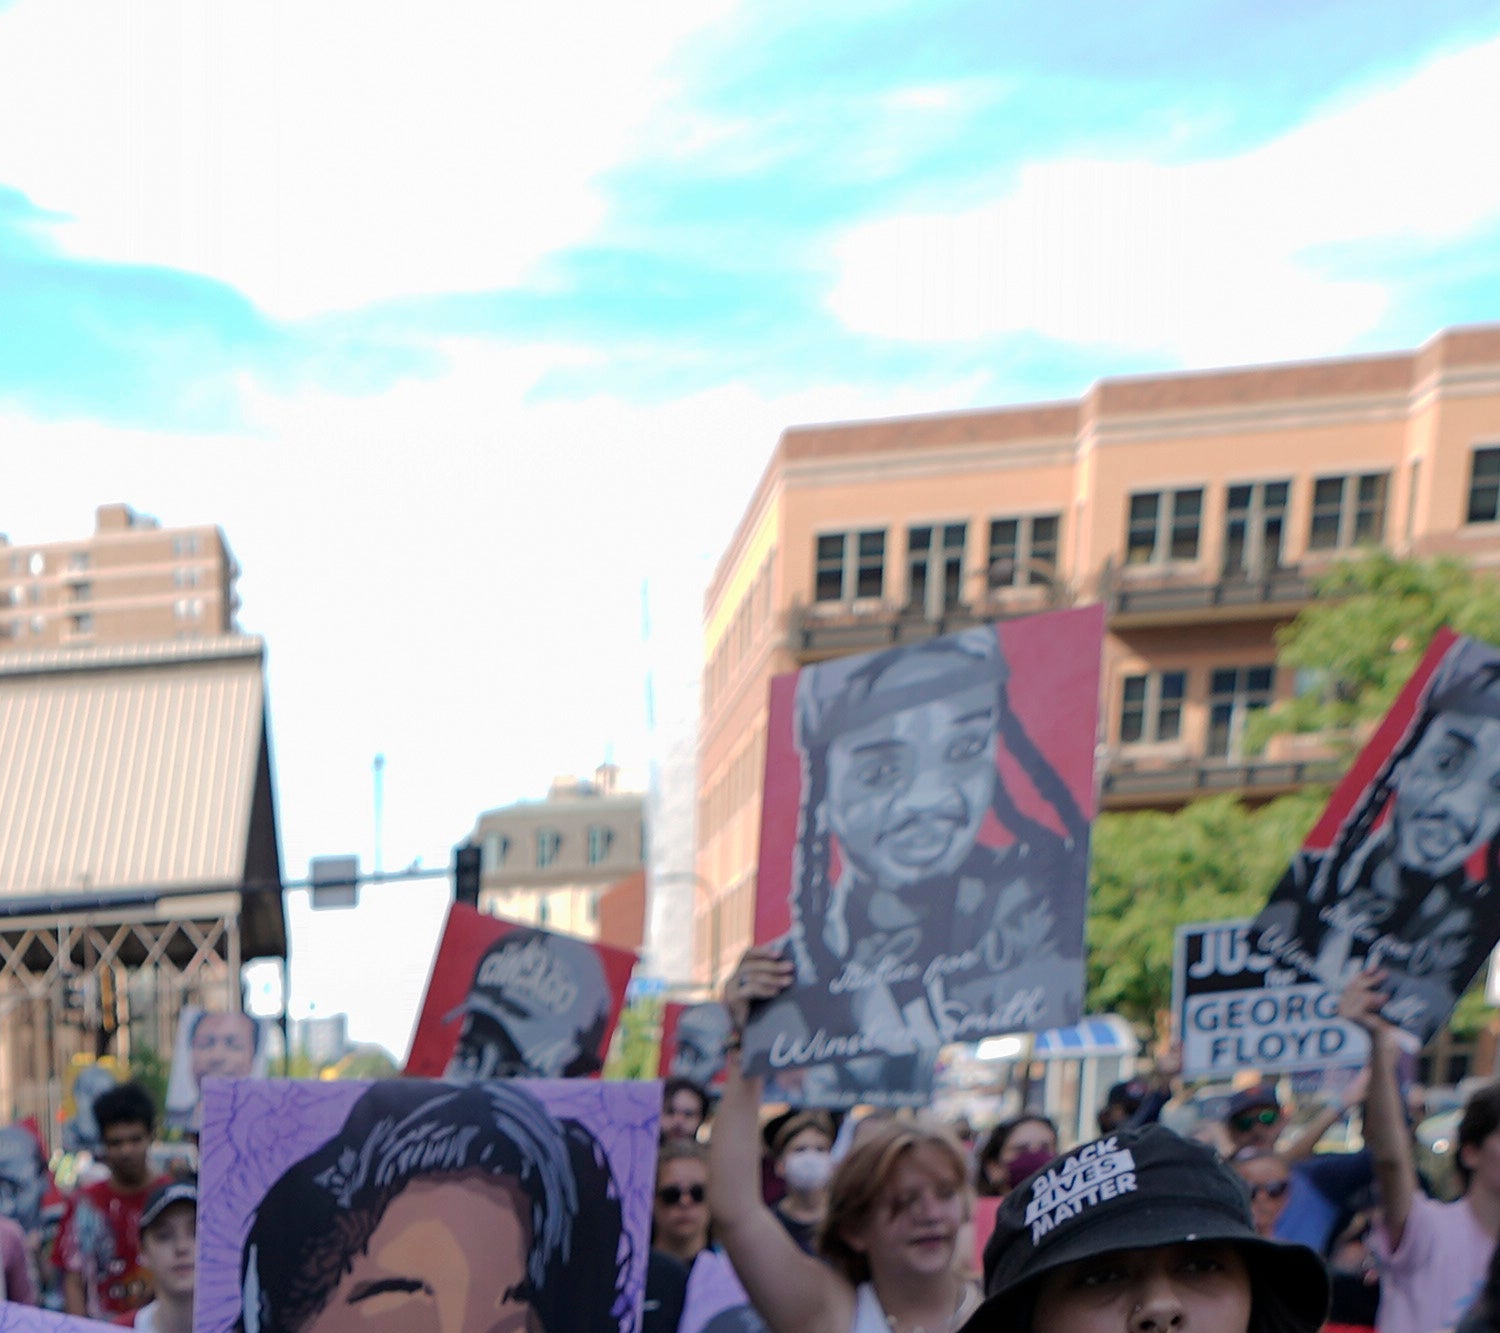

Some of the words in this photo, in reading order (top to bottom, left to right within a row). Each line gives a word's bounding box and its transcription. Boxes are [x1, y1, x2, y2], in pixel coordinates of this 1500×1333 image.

[1188, 929, 1275, 980] JUS
[1194, 991, 1341, 1032] GEORG
[1210, 1026, 1346, 1066] FLOYD
[1030, 1154, 1122, 1215] LIVES
[1031, 1136, 1119, 1199] BLACK
[1032, 1172, 1139, 1248] MATTER
